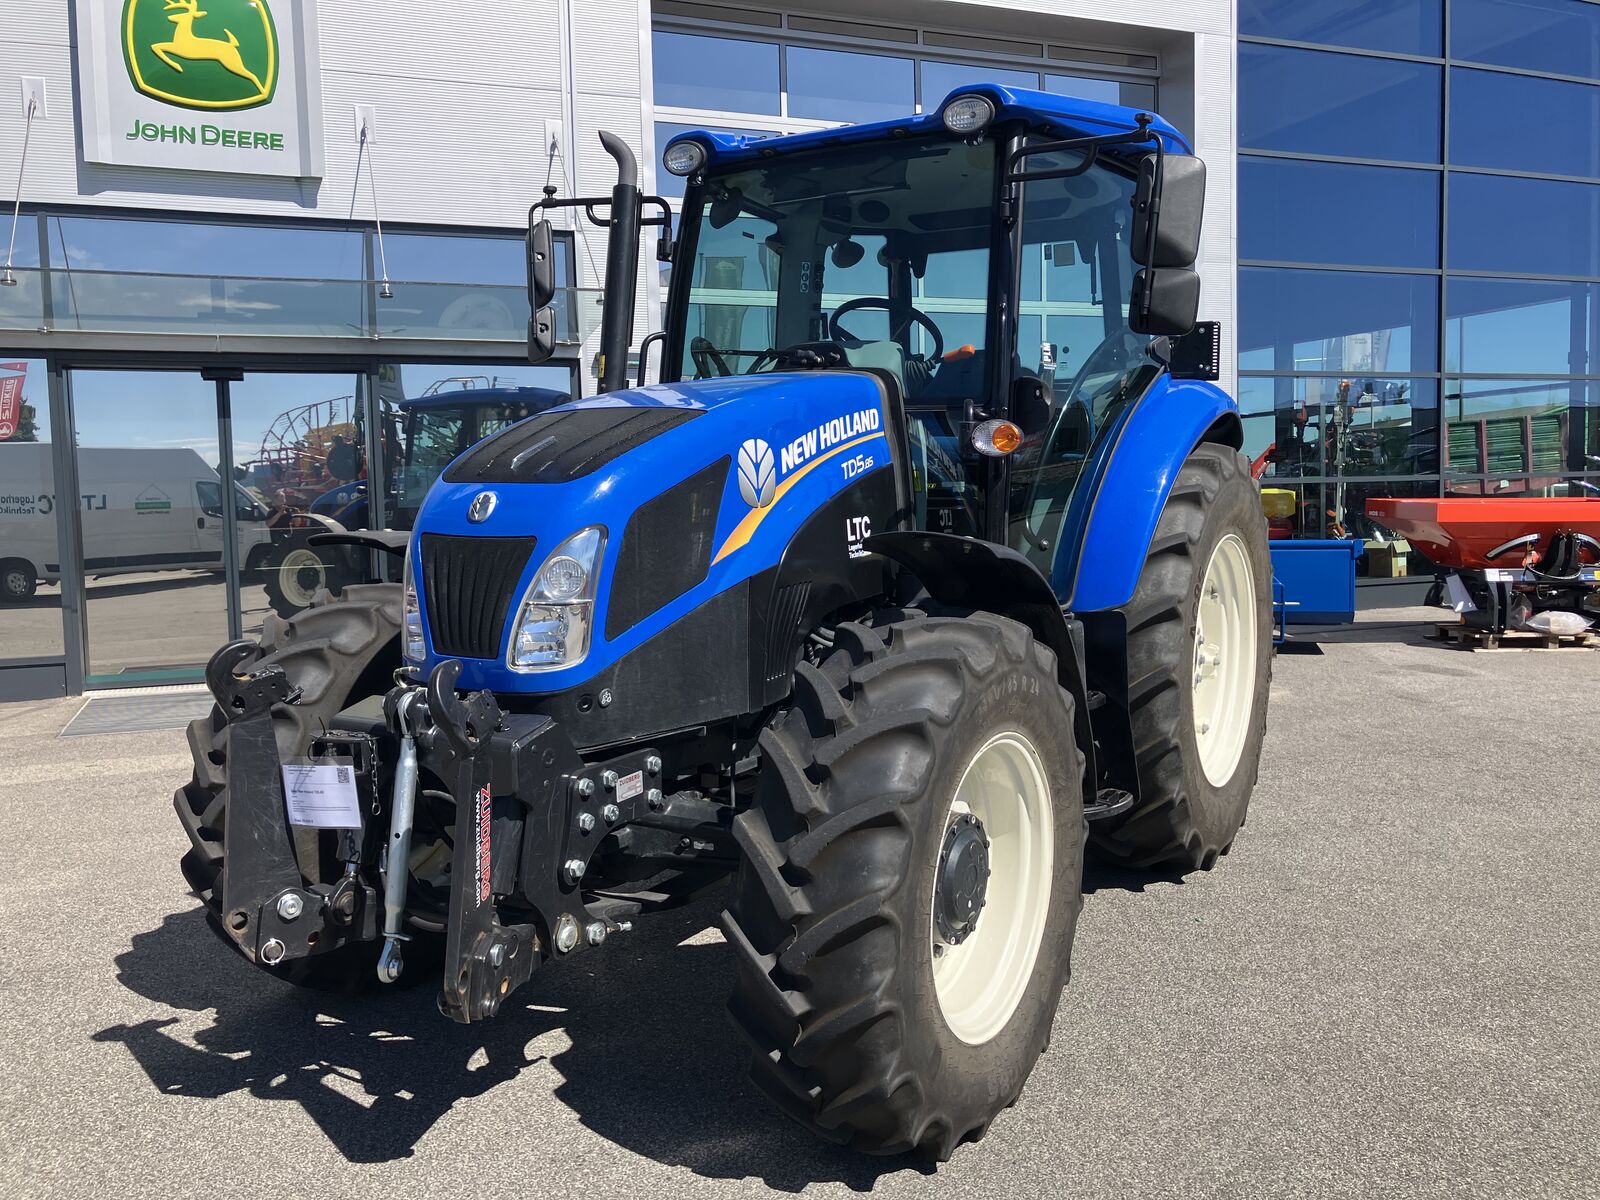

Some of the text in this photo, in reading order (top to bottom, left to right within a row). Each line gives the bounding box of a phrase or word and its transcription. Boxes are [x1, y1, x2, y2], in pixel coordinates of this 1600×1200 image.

[126, 119, 284, 151] JOHN DEERE
[781, 428, 817, 475] NEW
[819, 408, 879, 450] HOLLAND
[846, 516, 871, 542] LTC
[480, 782, 491, 901] ZUIDBERG
